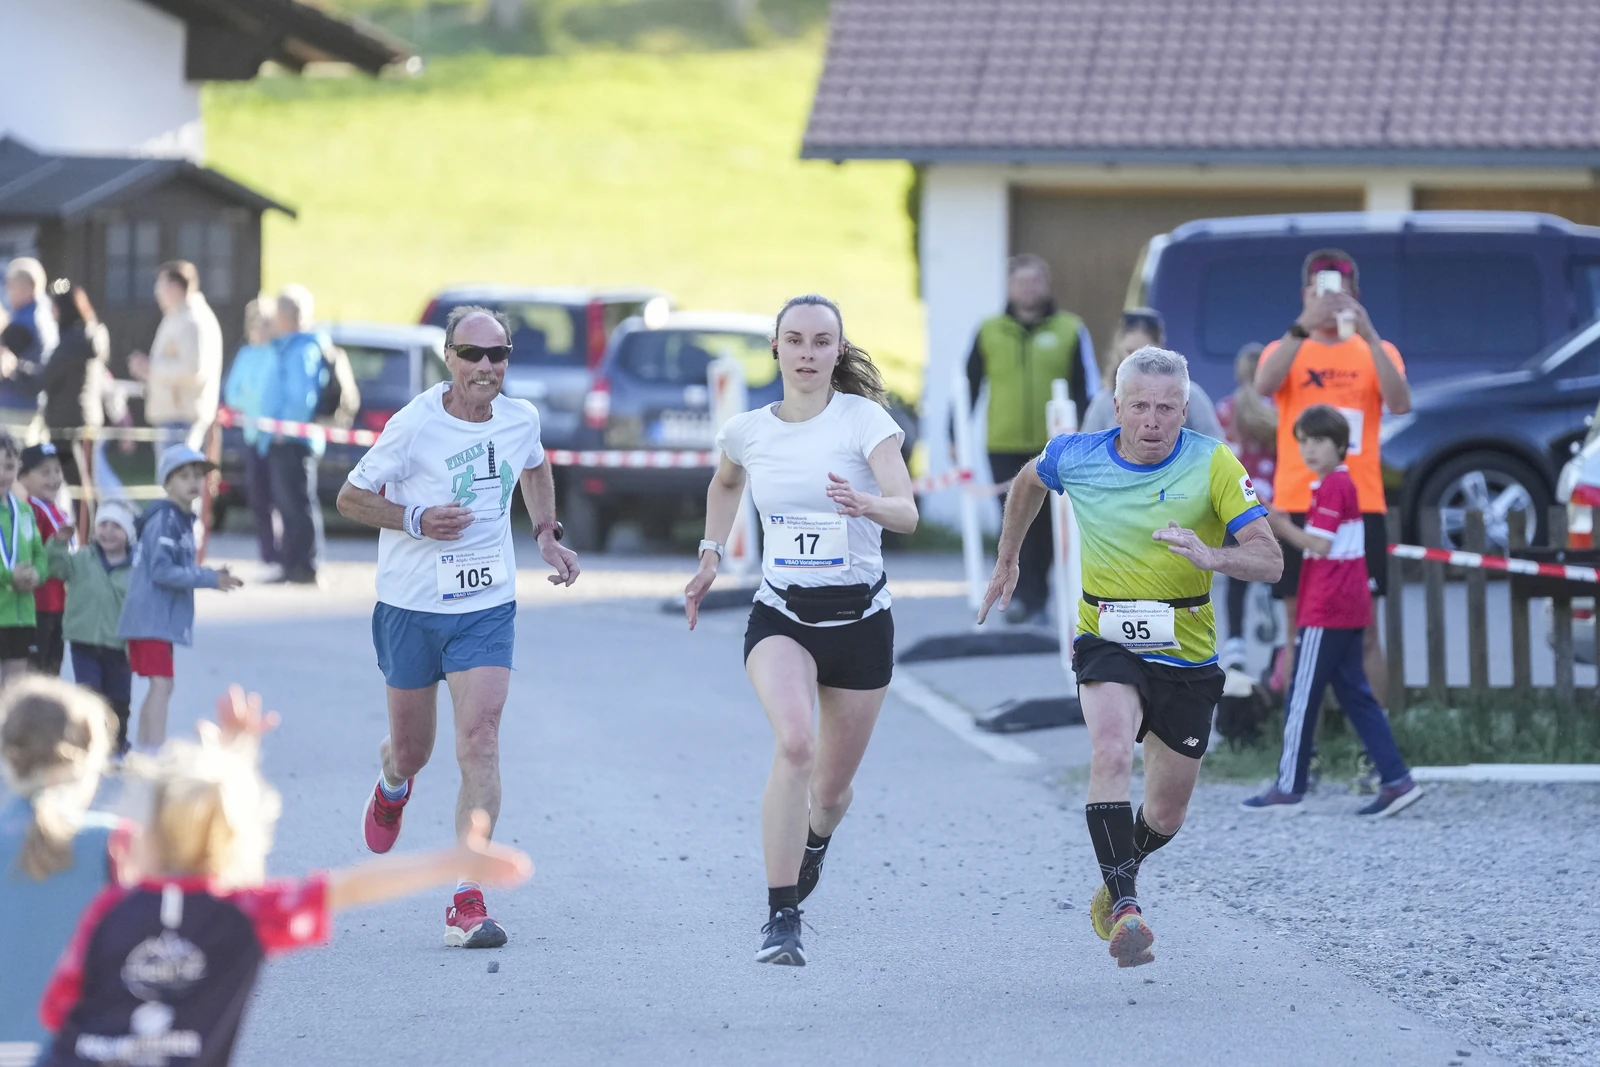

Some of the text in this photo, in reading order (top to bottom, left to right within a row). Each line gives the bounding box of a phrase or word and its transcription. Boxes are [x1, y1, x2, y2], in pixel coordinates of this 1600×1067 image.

[444, 442, 486, 471] FINALE
[794, 533, 820, 555] 17
[455, 567, 493, 589] 105
[1121, 620, 1151, 640] 95
